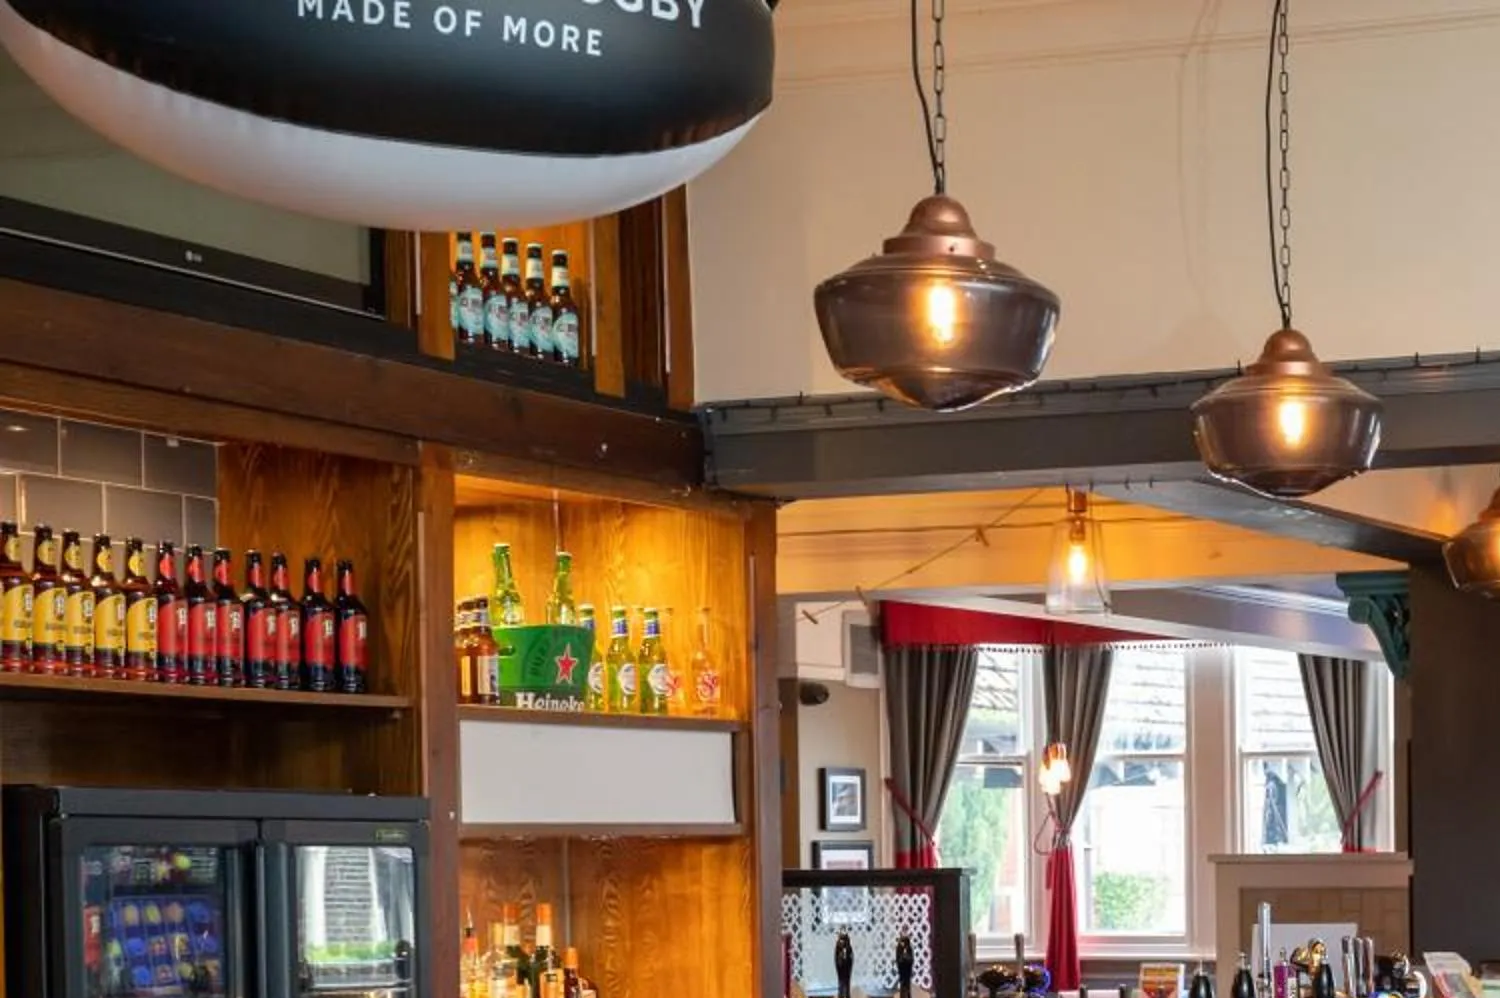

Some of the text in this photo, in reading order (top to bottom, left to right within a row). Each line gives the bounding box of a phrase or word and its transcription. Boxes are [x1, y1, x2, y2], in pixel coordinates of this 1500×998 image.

[297, 0, 603, 56] MADE OF MORE
